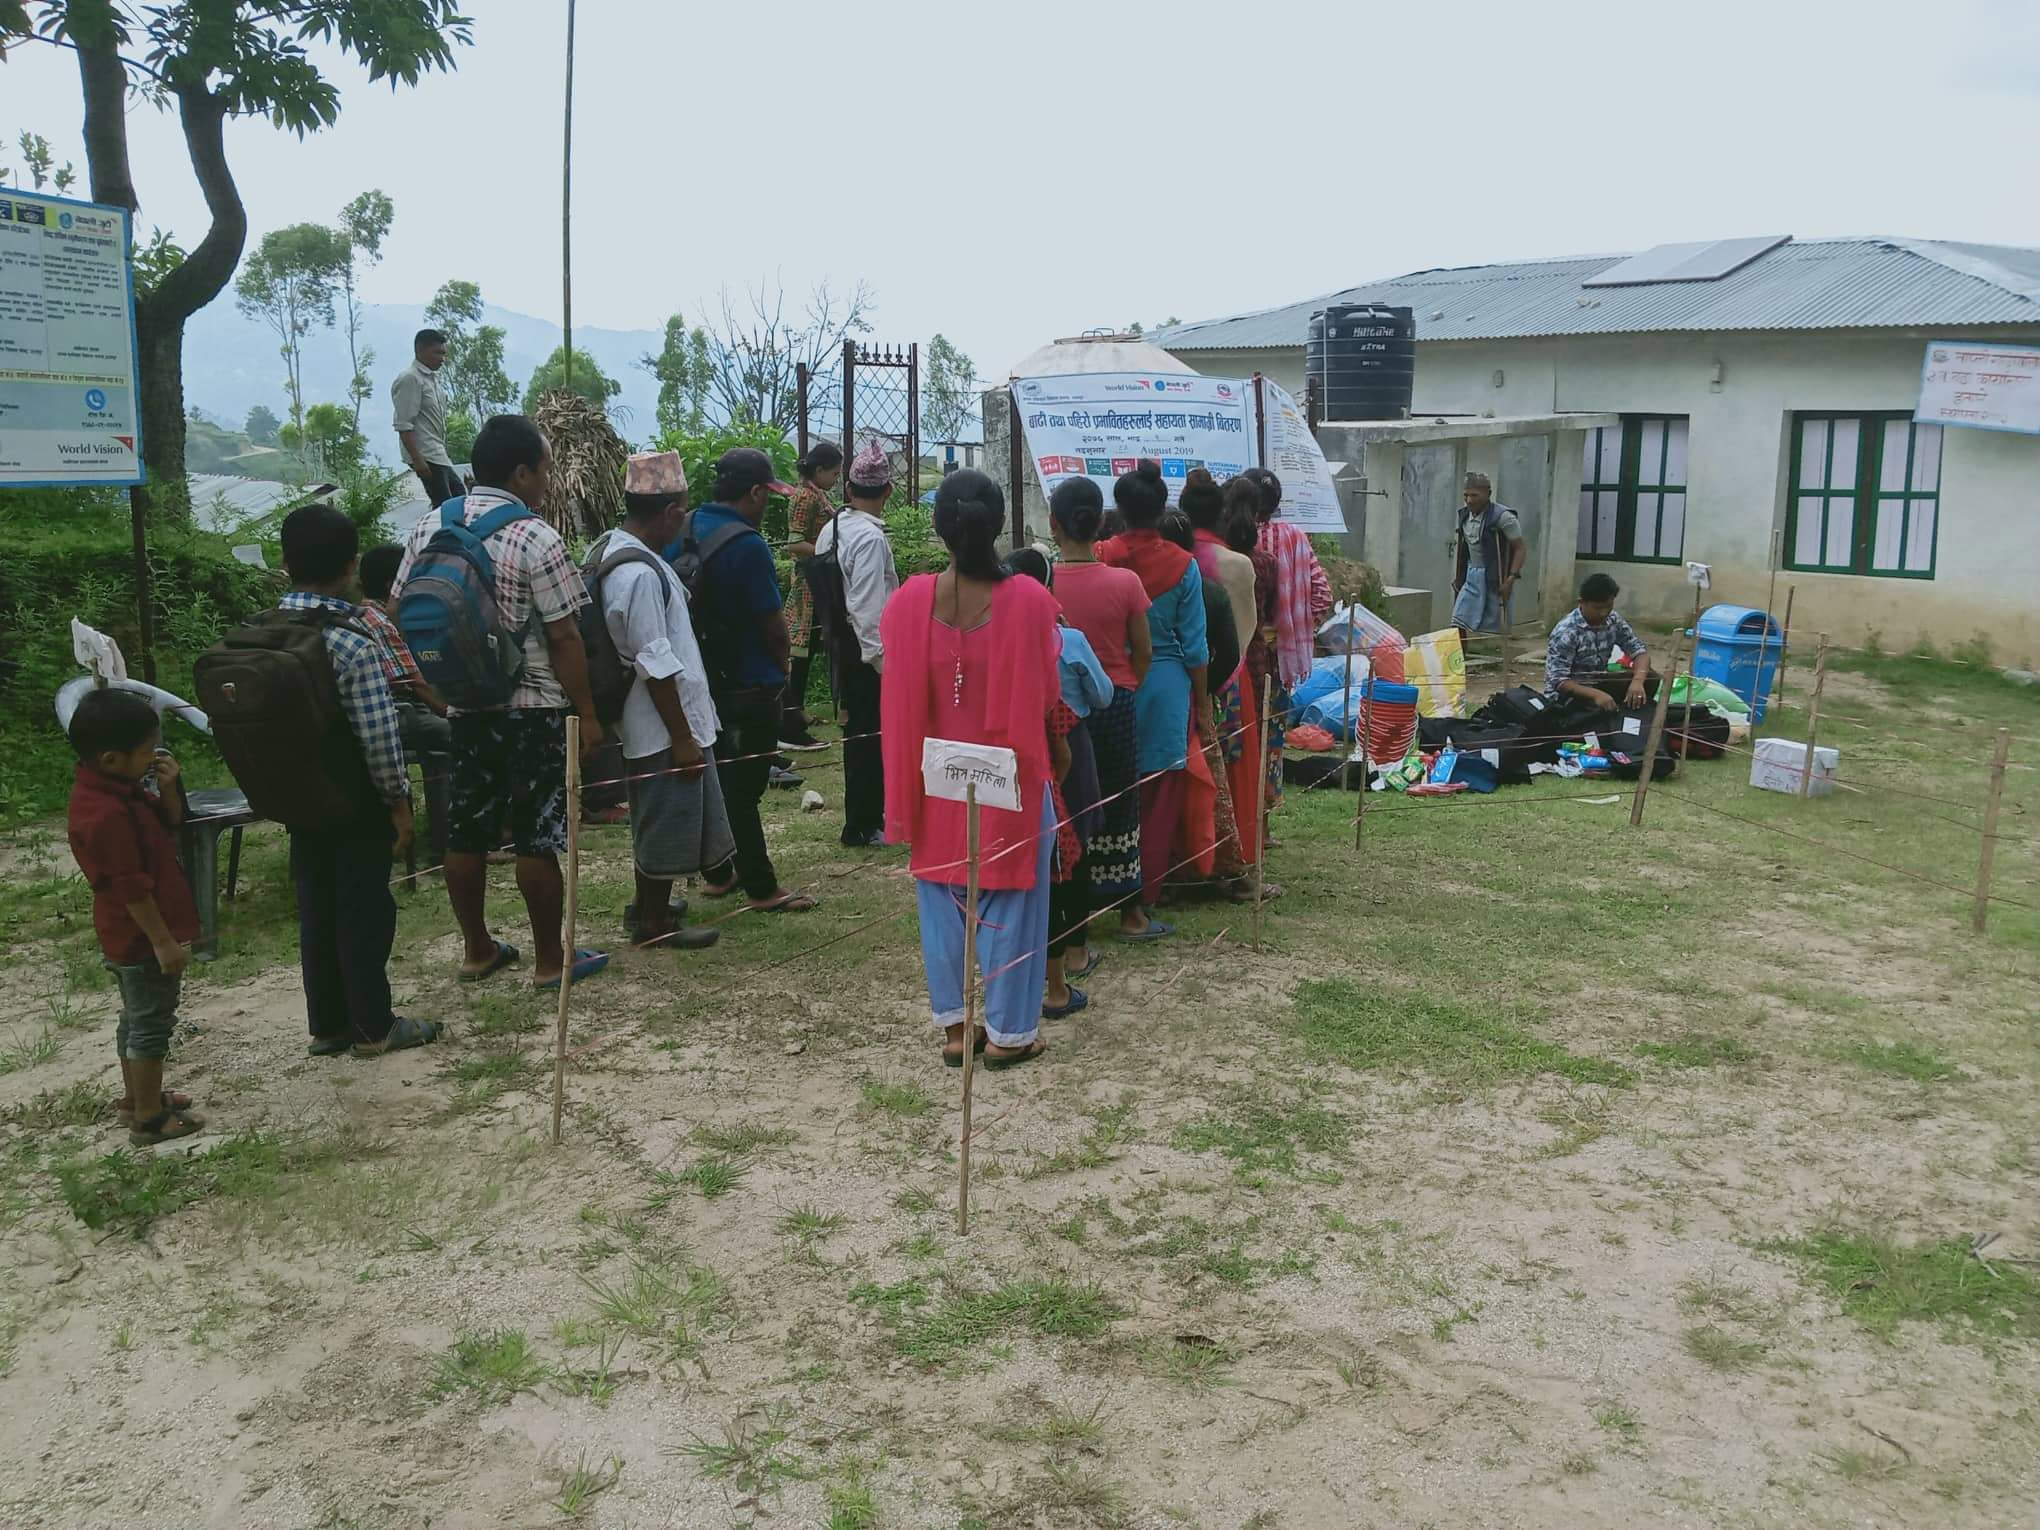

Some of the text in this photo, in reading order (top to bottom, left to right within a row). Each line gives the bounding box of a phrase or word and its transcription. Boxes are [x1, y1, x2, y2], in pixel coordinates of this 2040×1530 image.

[1028, 410, 1047, 428] बाढी
[1048, 414, 1066, 427] तथा
[1067, 411, 1091, 429] पहिरो
[1154, 414, 1187, 429] सहायता
[1215, 411, 1242, 432] वितरण
[57, 443, 123, 455] World Vision
[1141, 447, 1194, 456] August 2019
